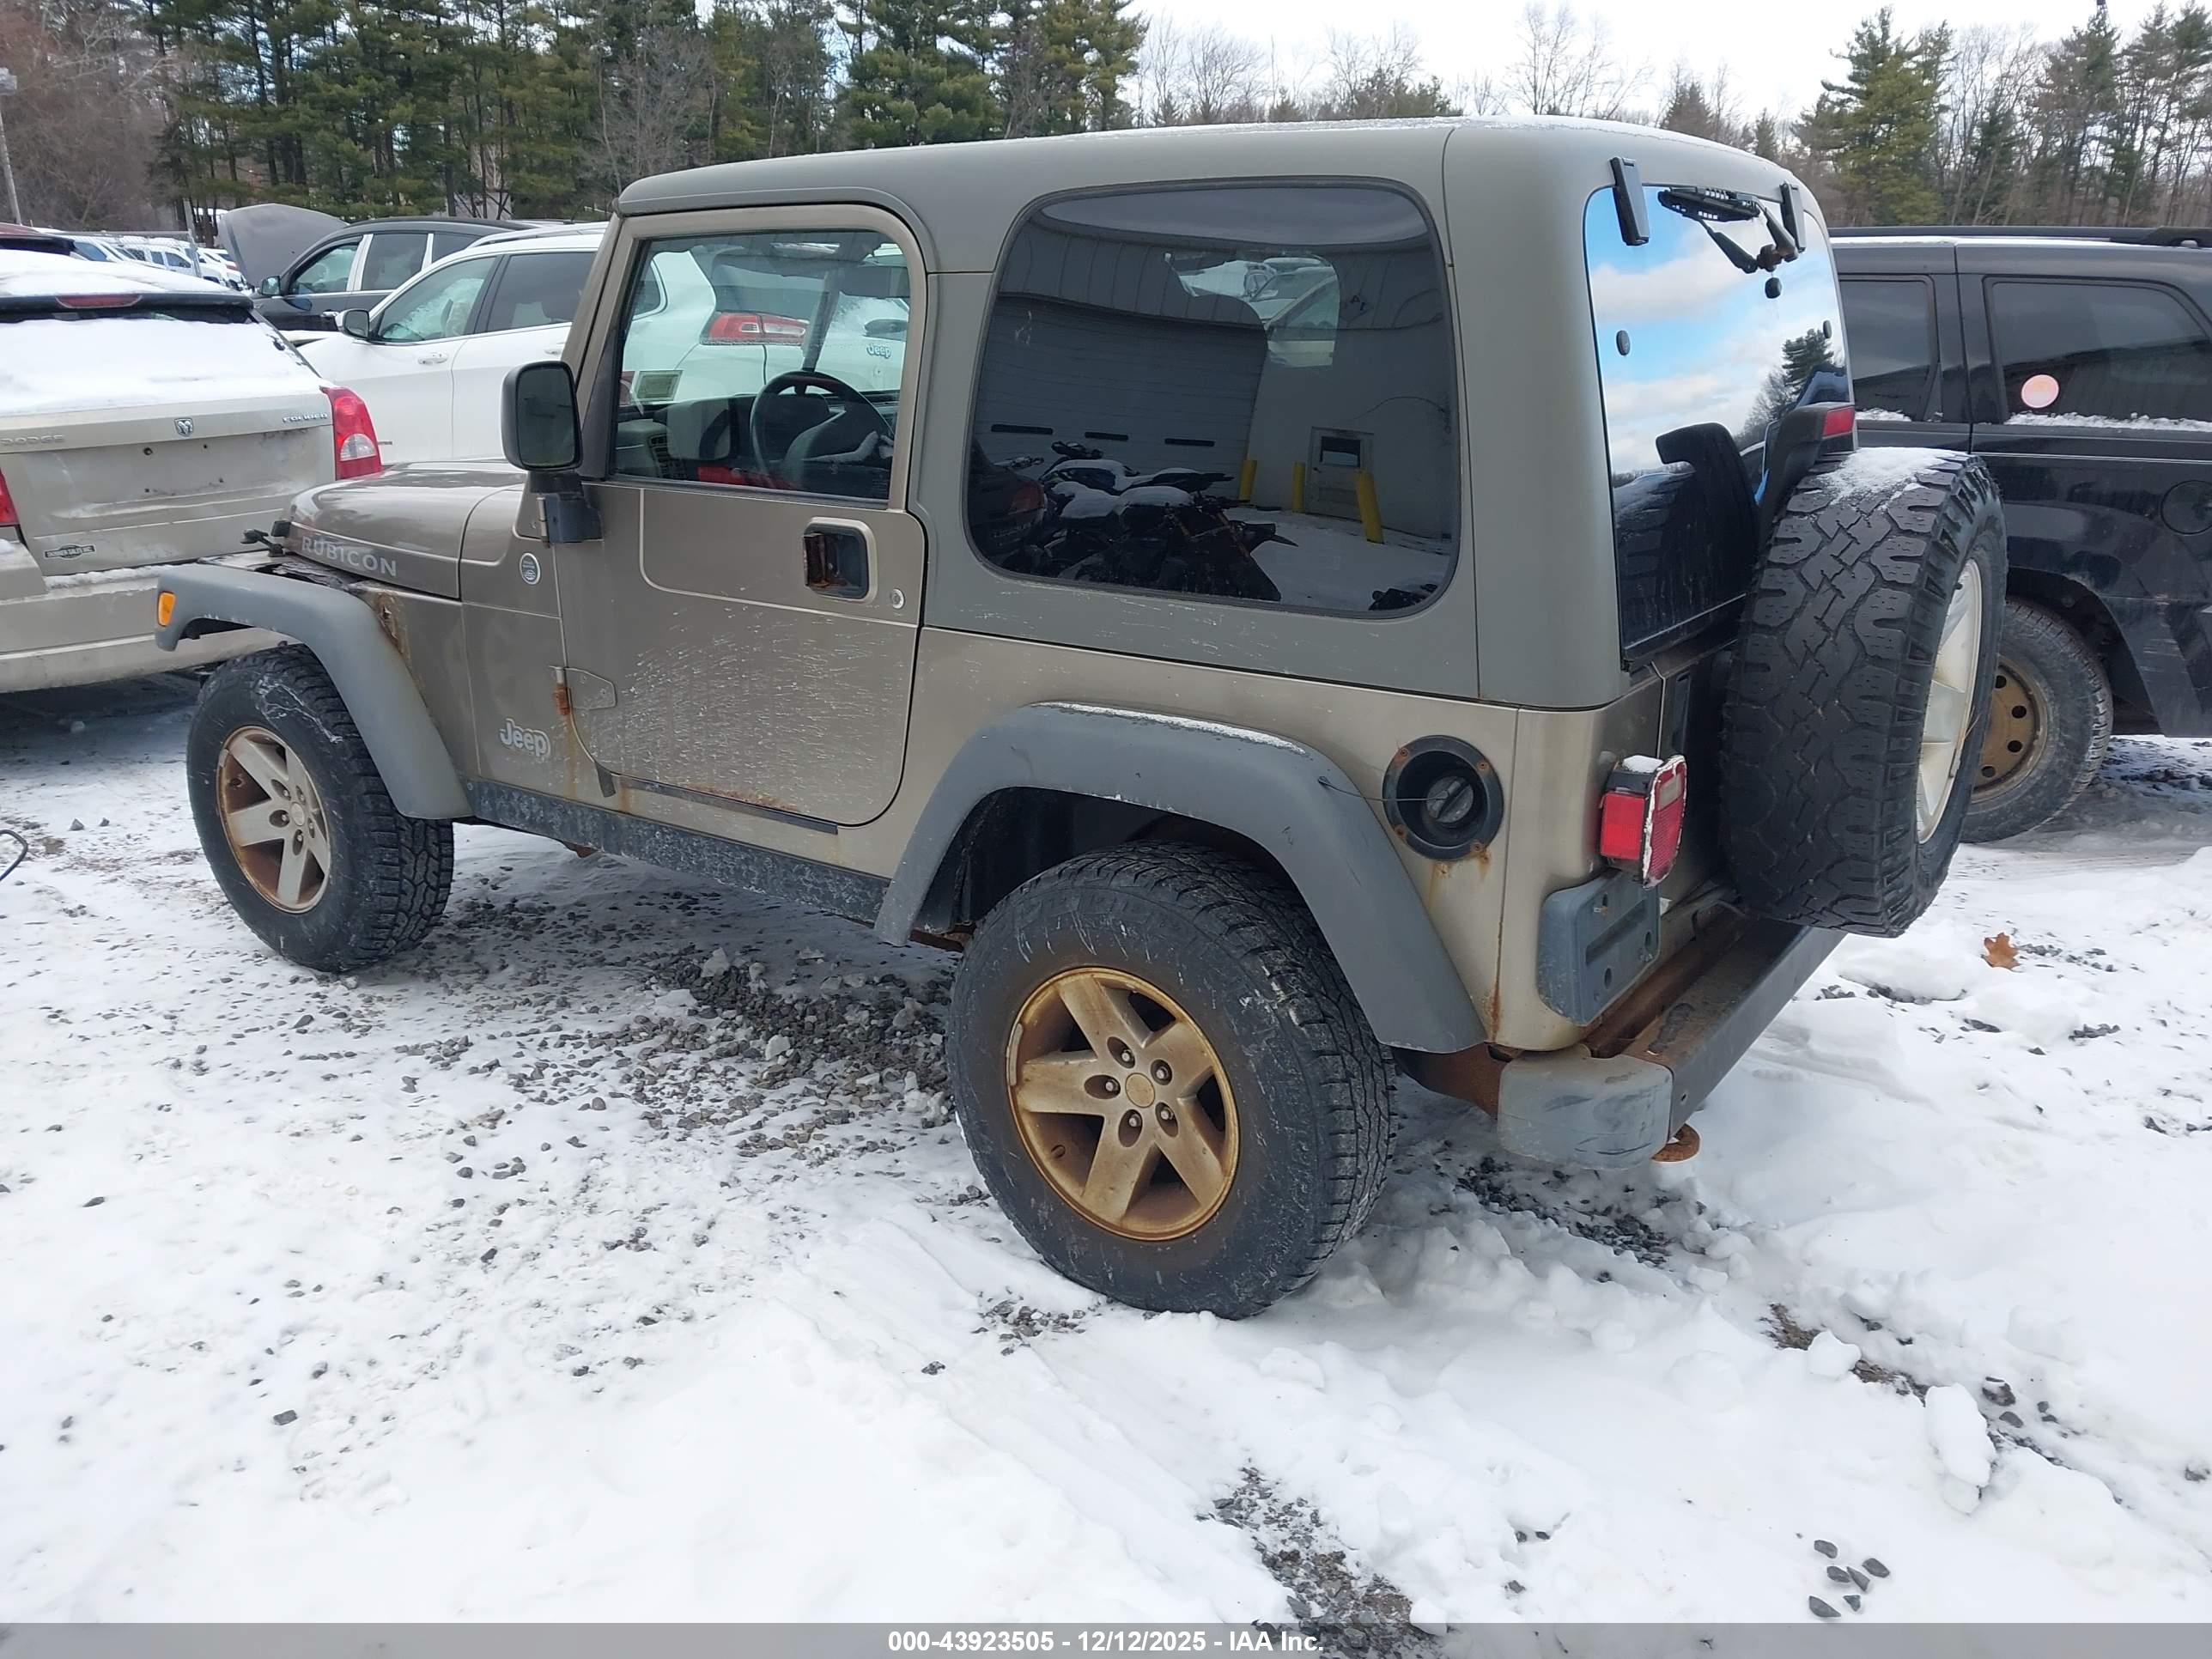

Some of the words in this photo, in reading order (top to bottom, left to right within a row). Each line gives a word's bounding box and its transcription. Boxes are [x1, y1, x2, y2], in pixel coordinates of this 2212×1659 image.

[866, 343, 891, 359] Jeep
[0, 434, 65, 446] DODGE
[301, 535, 397, 577] RUBICON
[499, 718, 550, 757] Jeep
